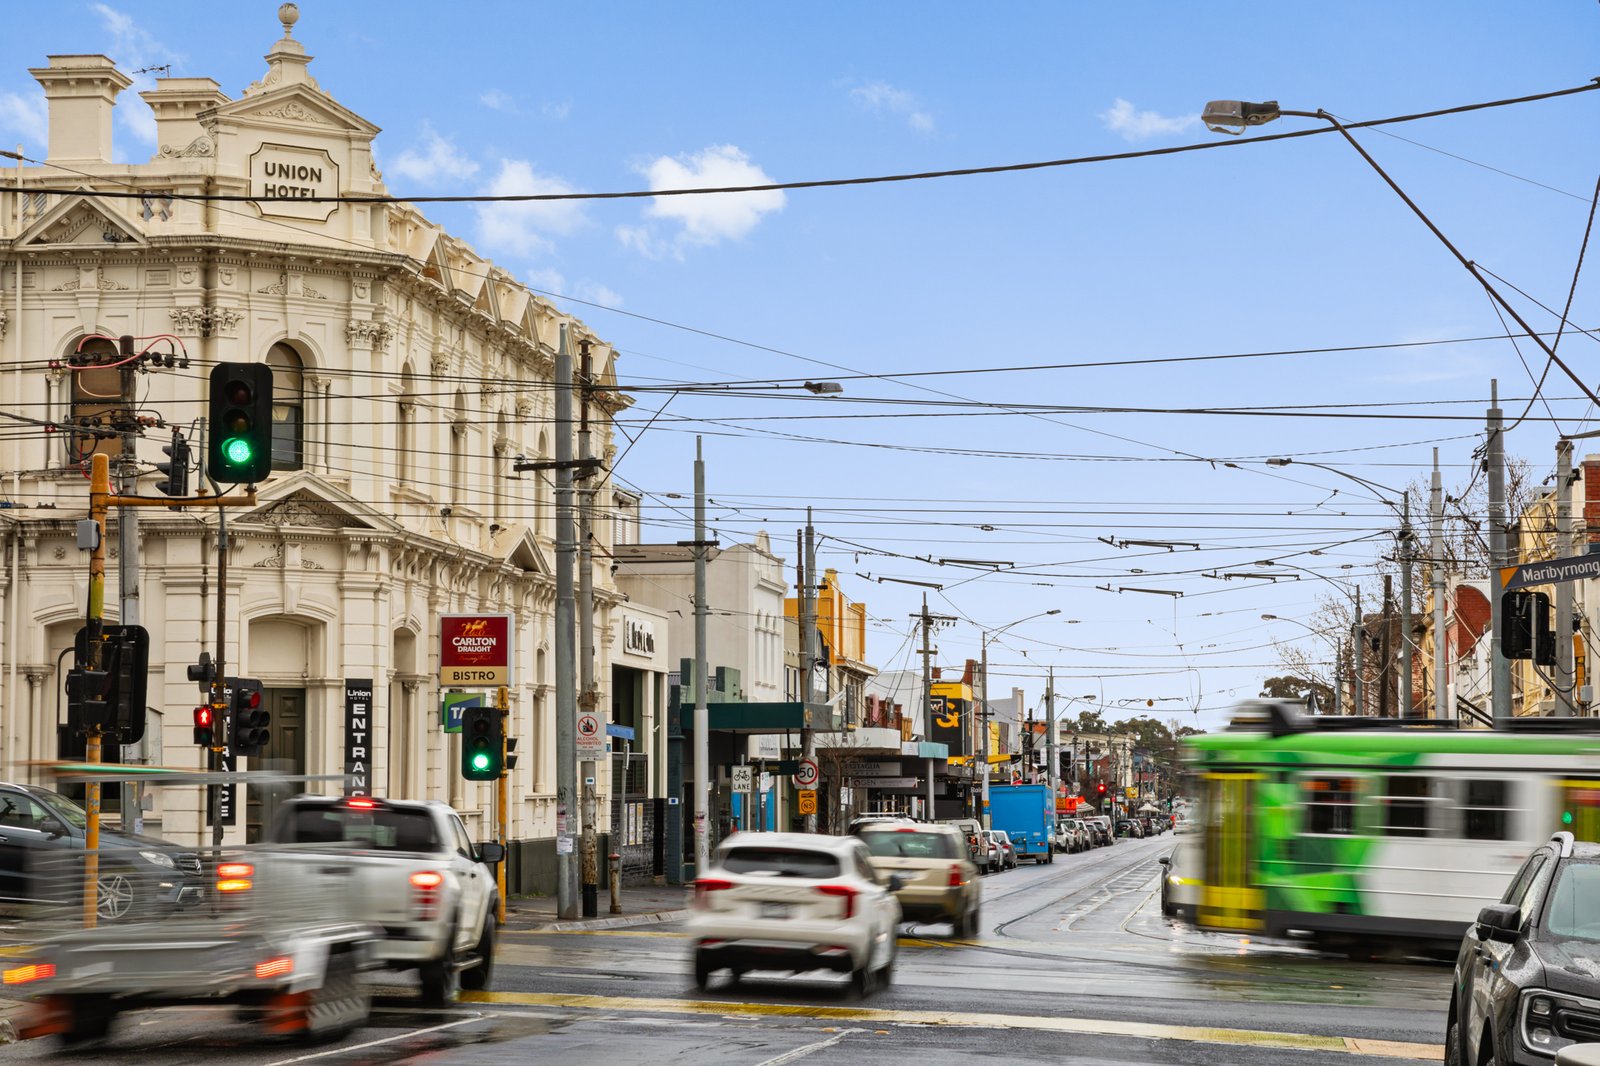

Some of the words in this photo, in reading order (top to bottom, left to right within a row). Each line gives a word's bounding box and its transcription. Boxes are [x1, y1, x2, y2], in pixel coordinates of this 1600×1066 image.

[264, 161, 322, 183] UNION
[264, 183, 321, 202] HOTEL
[1522, 561, 1600, 582] Maribyrnong
[452, 637, 496, 646] CARLTON
[453, 671, 495, 681] BISTRO
[352, 704, 366, 797] ENTRANC
[799, 767, 815, 778] 50
[733, 783, 750, 791] LANE
